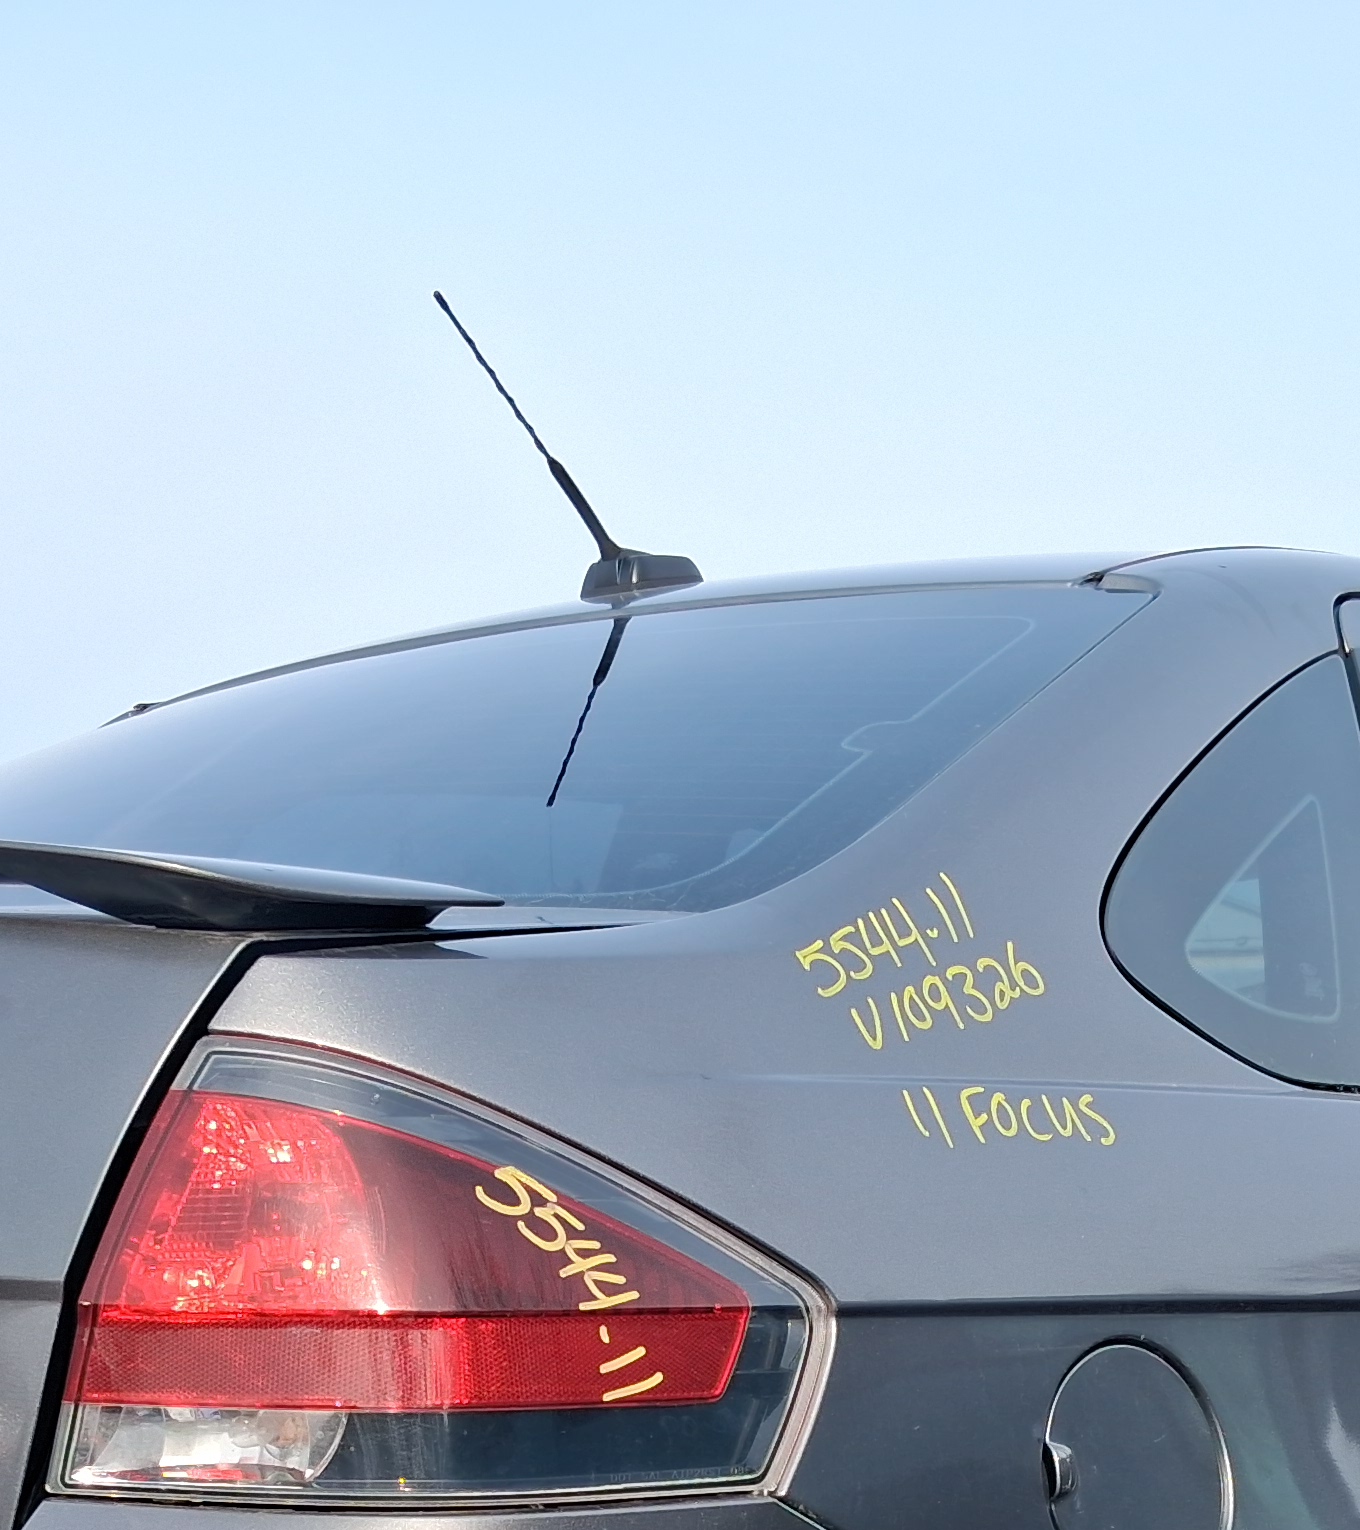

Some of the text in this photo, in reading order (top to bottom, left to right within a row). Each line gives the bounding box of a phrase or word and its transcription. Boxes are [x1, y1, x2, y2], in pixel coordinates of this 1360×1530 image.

[851, 941, 1044, 1050] V109326
[902, 1086, 1116, 1148] 11 FOCUS
